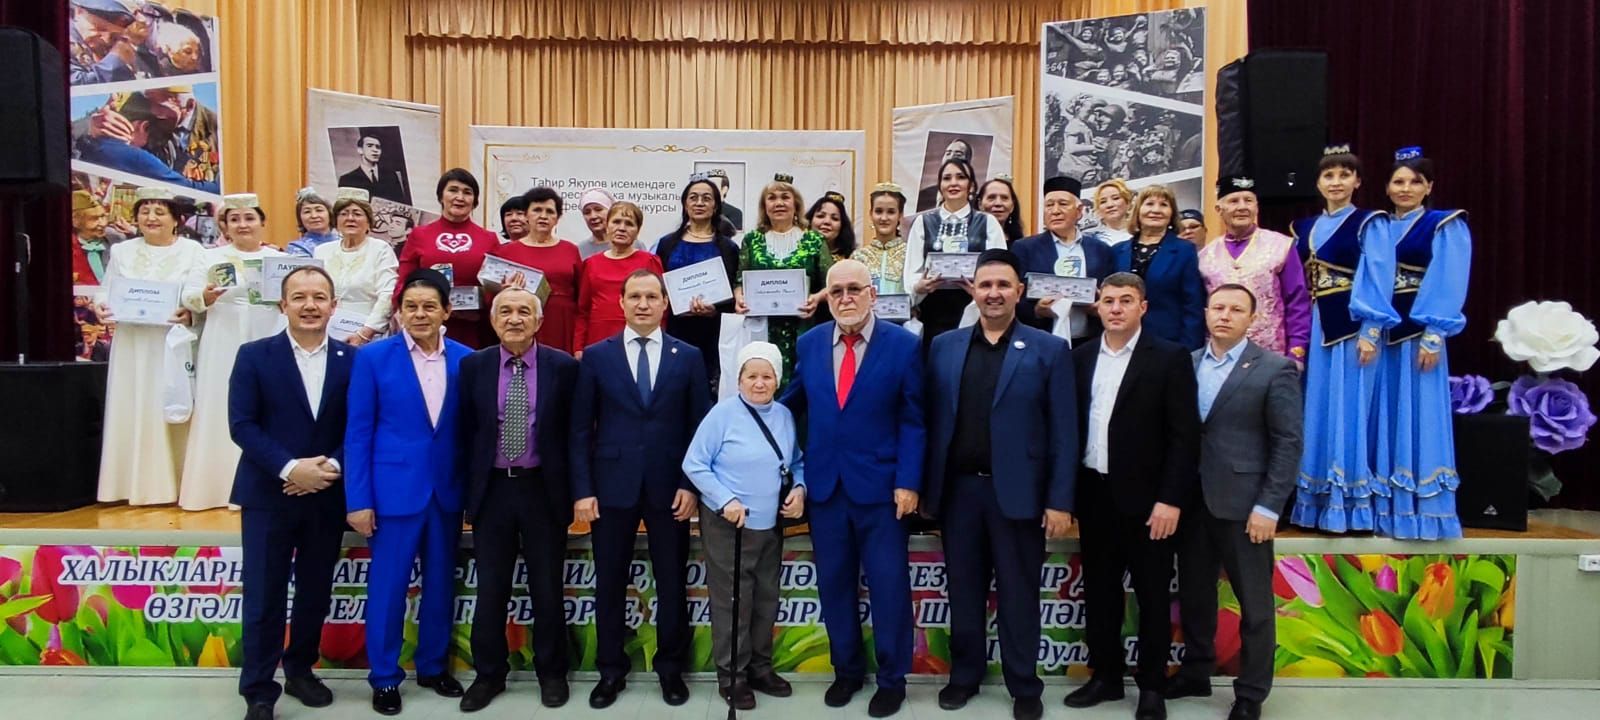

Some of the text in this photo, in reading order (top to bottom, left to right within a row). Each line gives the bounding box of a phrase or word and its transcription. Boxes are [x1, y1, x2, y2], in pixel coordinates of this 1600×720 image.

[568, 178, 607, 189] Якупов
[611, 180, 676, 190] исемендәге
[760, 279, 788, 287] ДИПЛОМ
[62, 559, 244, 582] ХАЛЫКЛАРН
